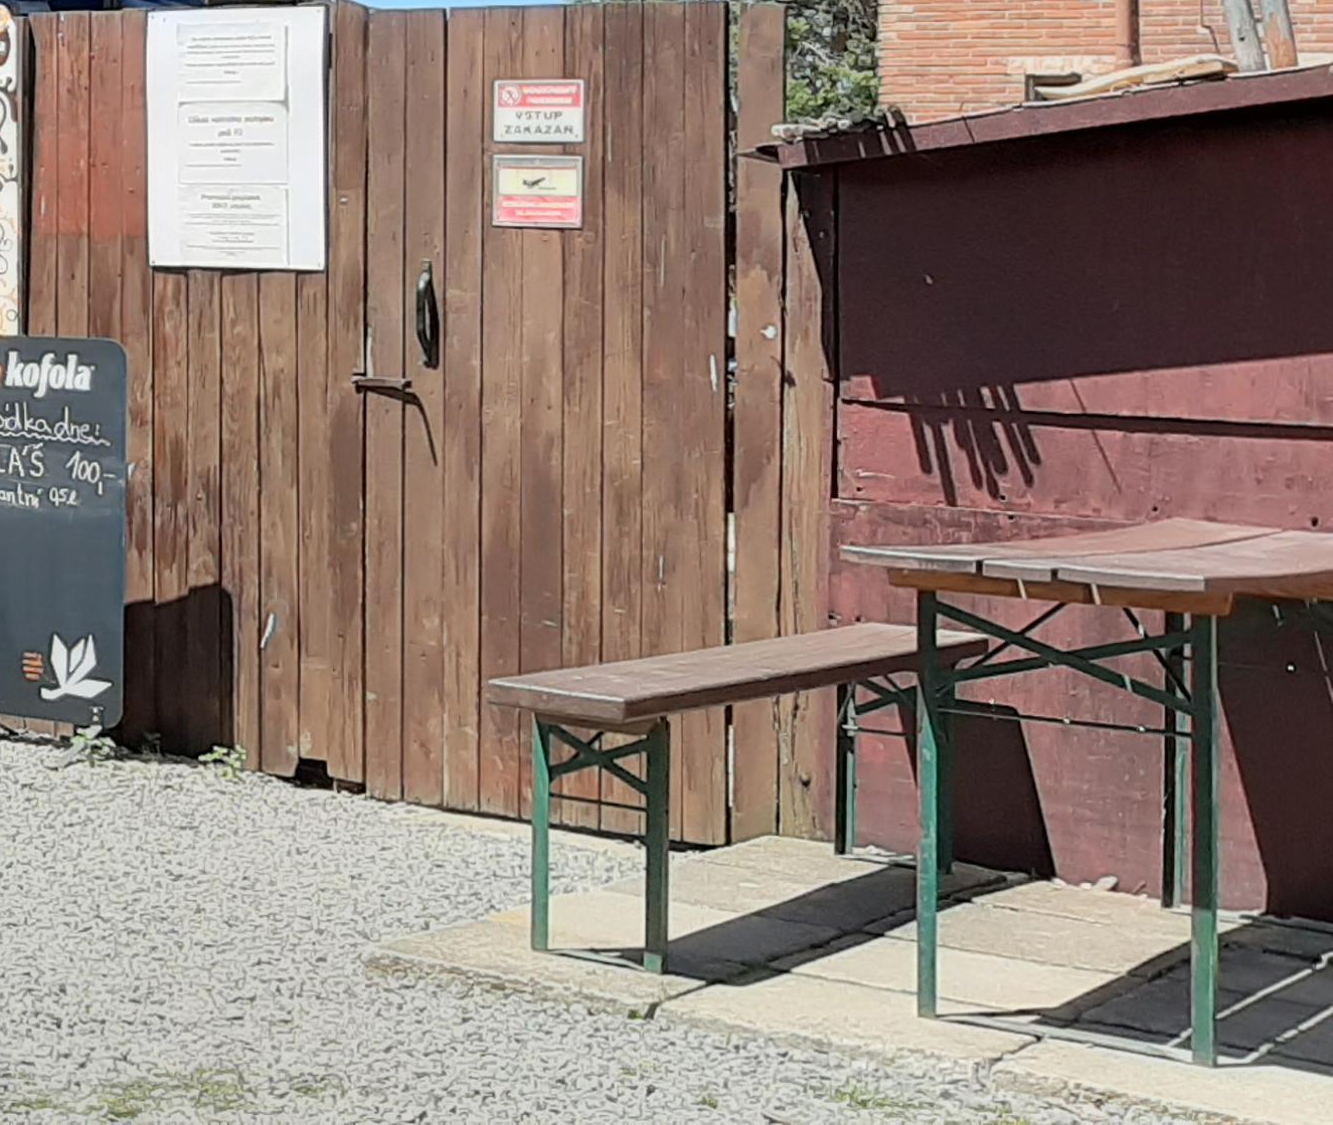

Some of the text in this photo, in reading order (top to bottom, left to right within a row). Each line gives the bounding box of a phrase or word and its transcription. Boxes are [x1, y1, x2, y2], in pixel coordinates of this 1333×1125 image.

[515, 110, 563, 121] VSTUP
[5, 351, 95, 398] kofola
[65, 450, 117, 495] 100,-
